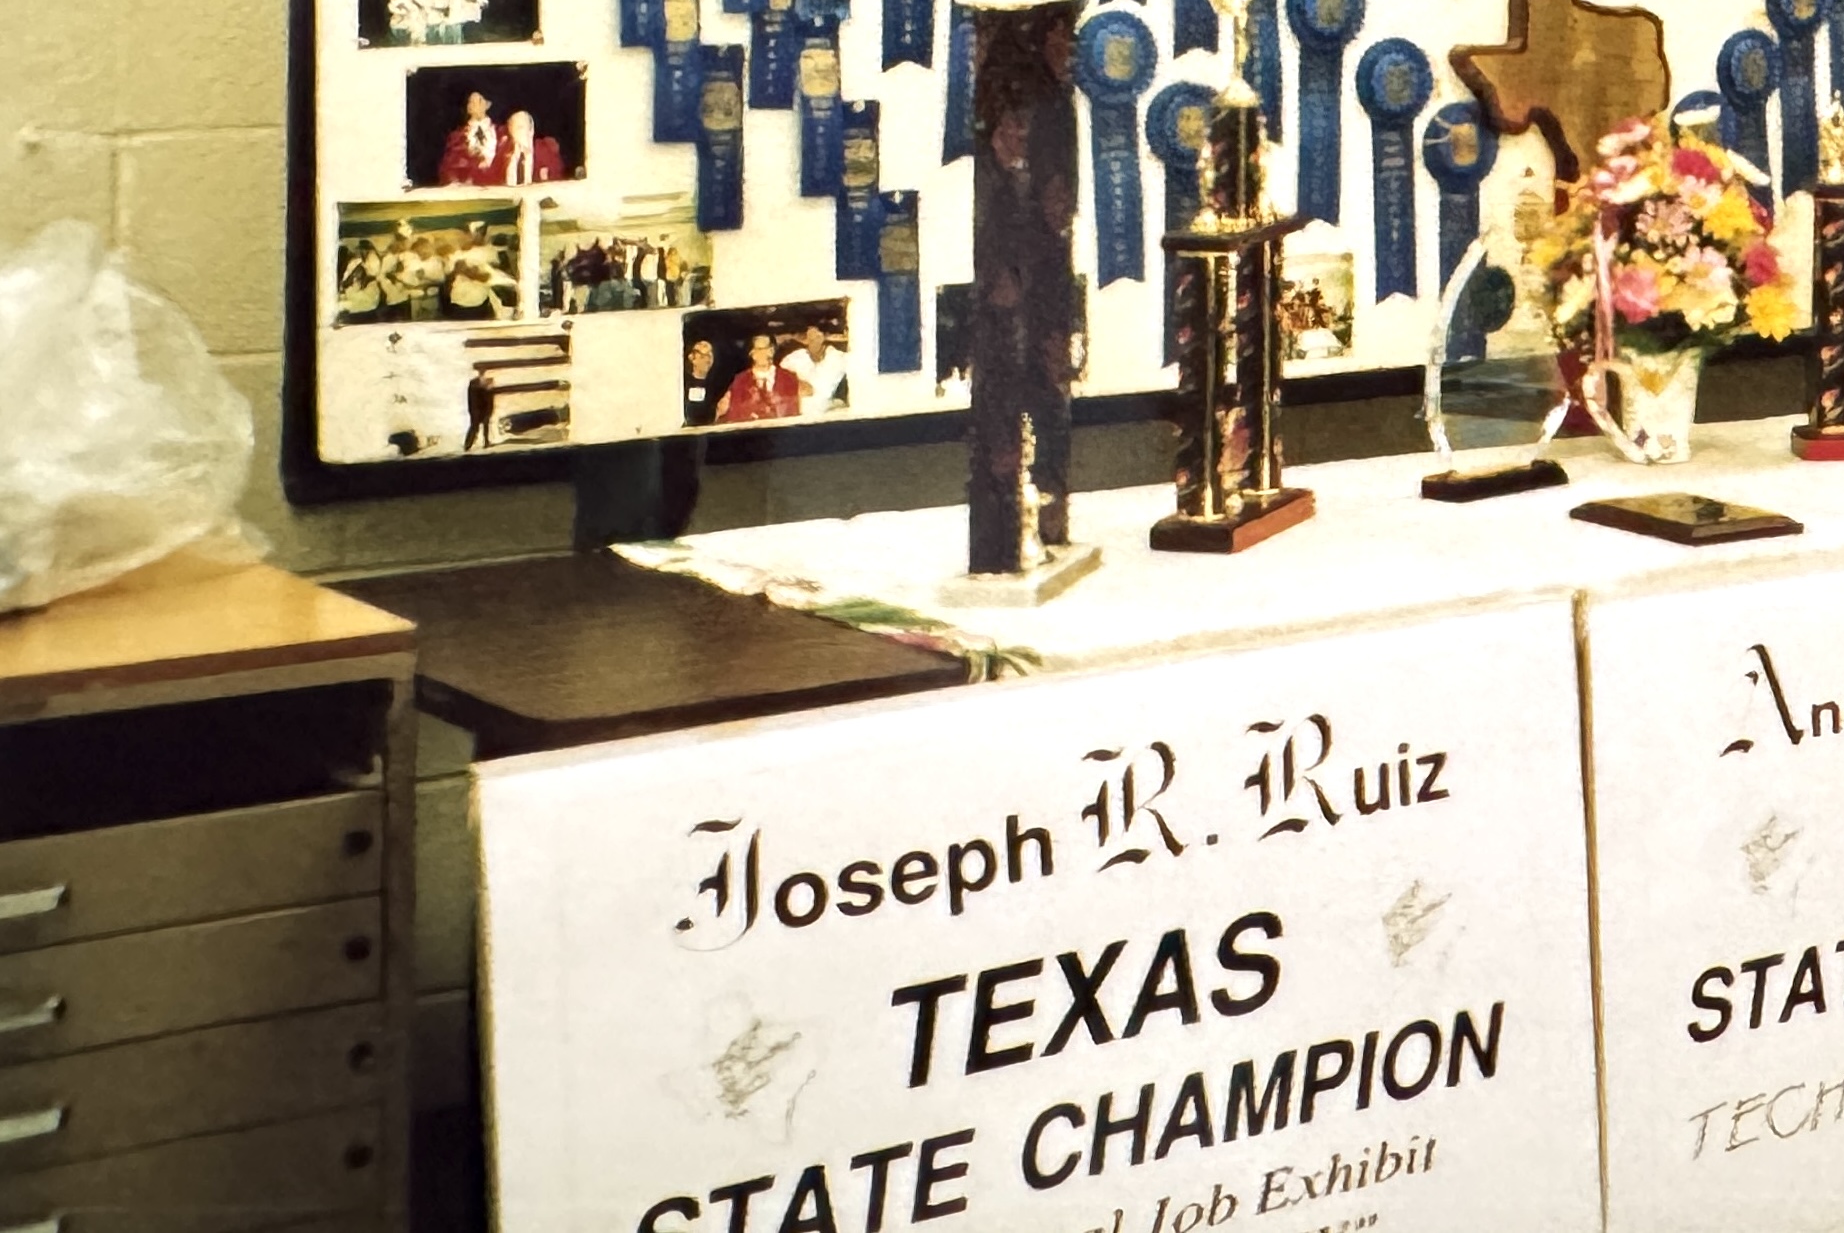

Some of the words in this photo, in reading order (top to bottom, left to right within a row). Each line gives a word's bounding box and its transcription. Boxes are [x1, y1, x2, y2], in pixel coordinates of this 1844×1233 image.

[671, 813, 1054, 953] Joseph
[1079, 739, 1221, 874] R.
[1243, 712, 1450, 842] Ruiz
[890, 910, 1284, 1090] TEXAS
[1020, 1000, 1505, 1191] CHAMPION
[1255, 1134, 1438, 1216] Exhibit
